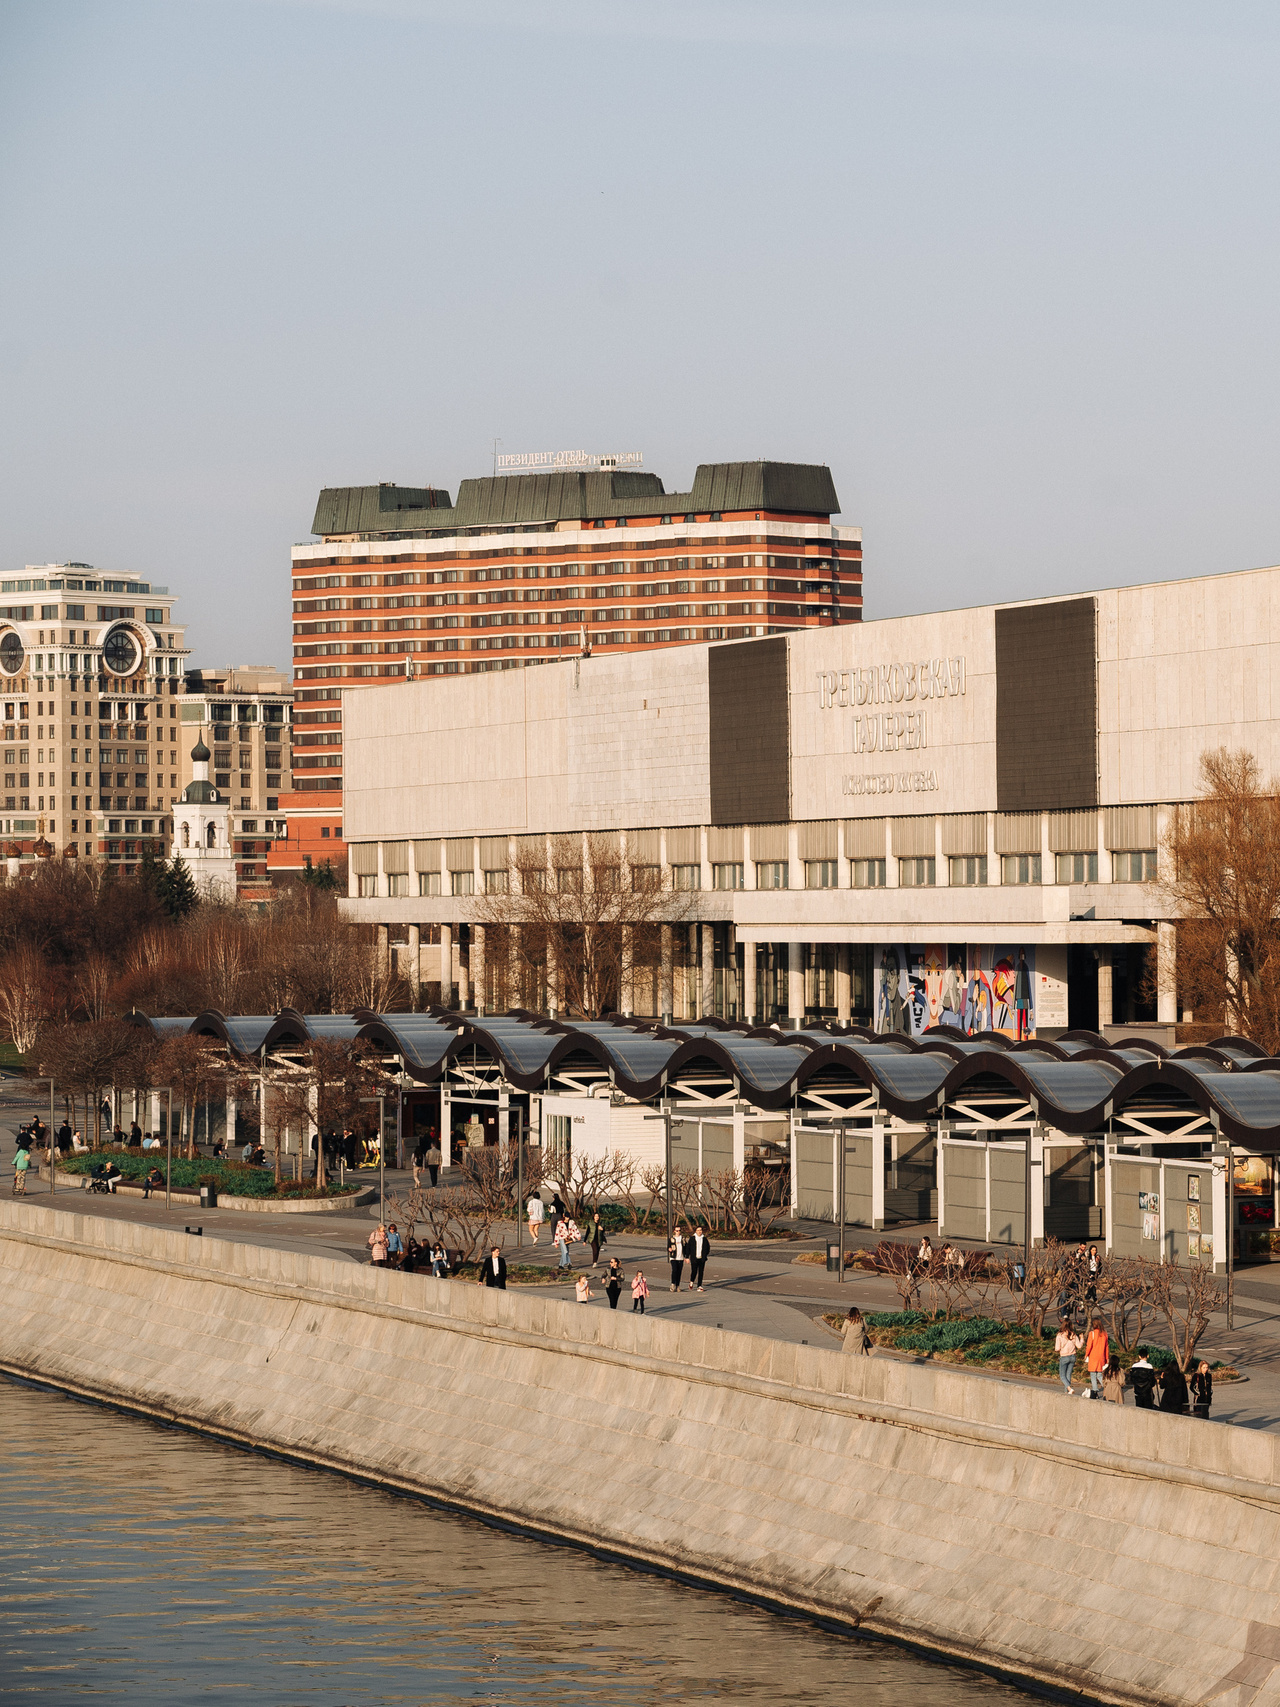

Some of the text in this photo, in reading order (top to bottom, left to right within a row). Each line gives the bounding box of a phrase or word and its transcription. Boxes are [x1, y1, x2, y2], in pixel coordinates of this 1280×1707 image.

[497, 450, 587, 467] ПРЕЗИДЕНТ-ОТЕЛЬ
[815, 656, 967, 709] ТРЕТЬЯКОВСКАЯ
[851, 710, 928, 754] ГАЛЕРЕЯ
